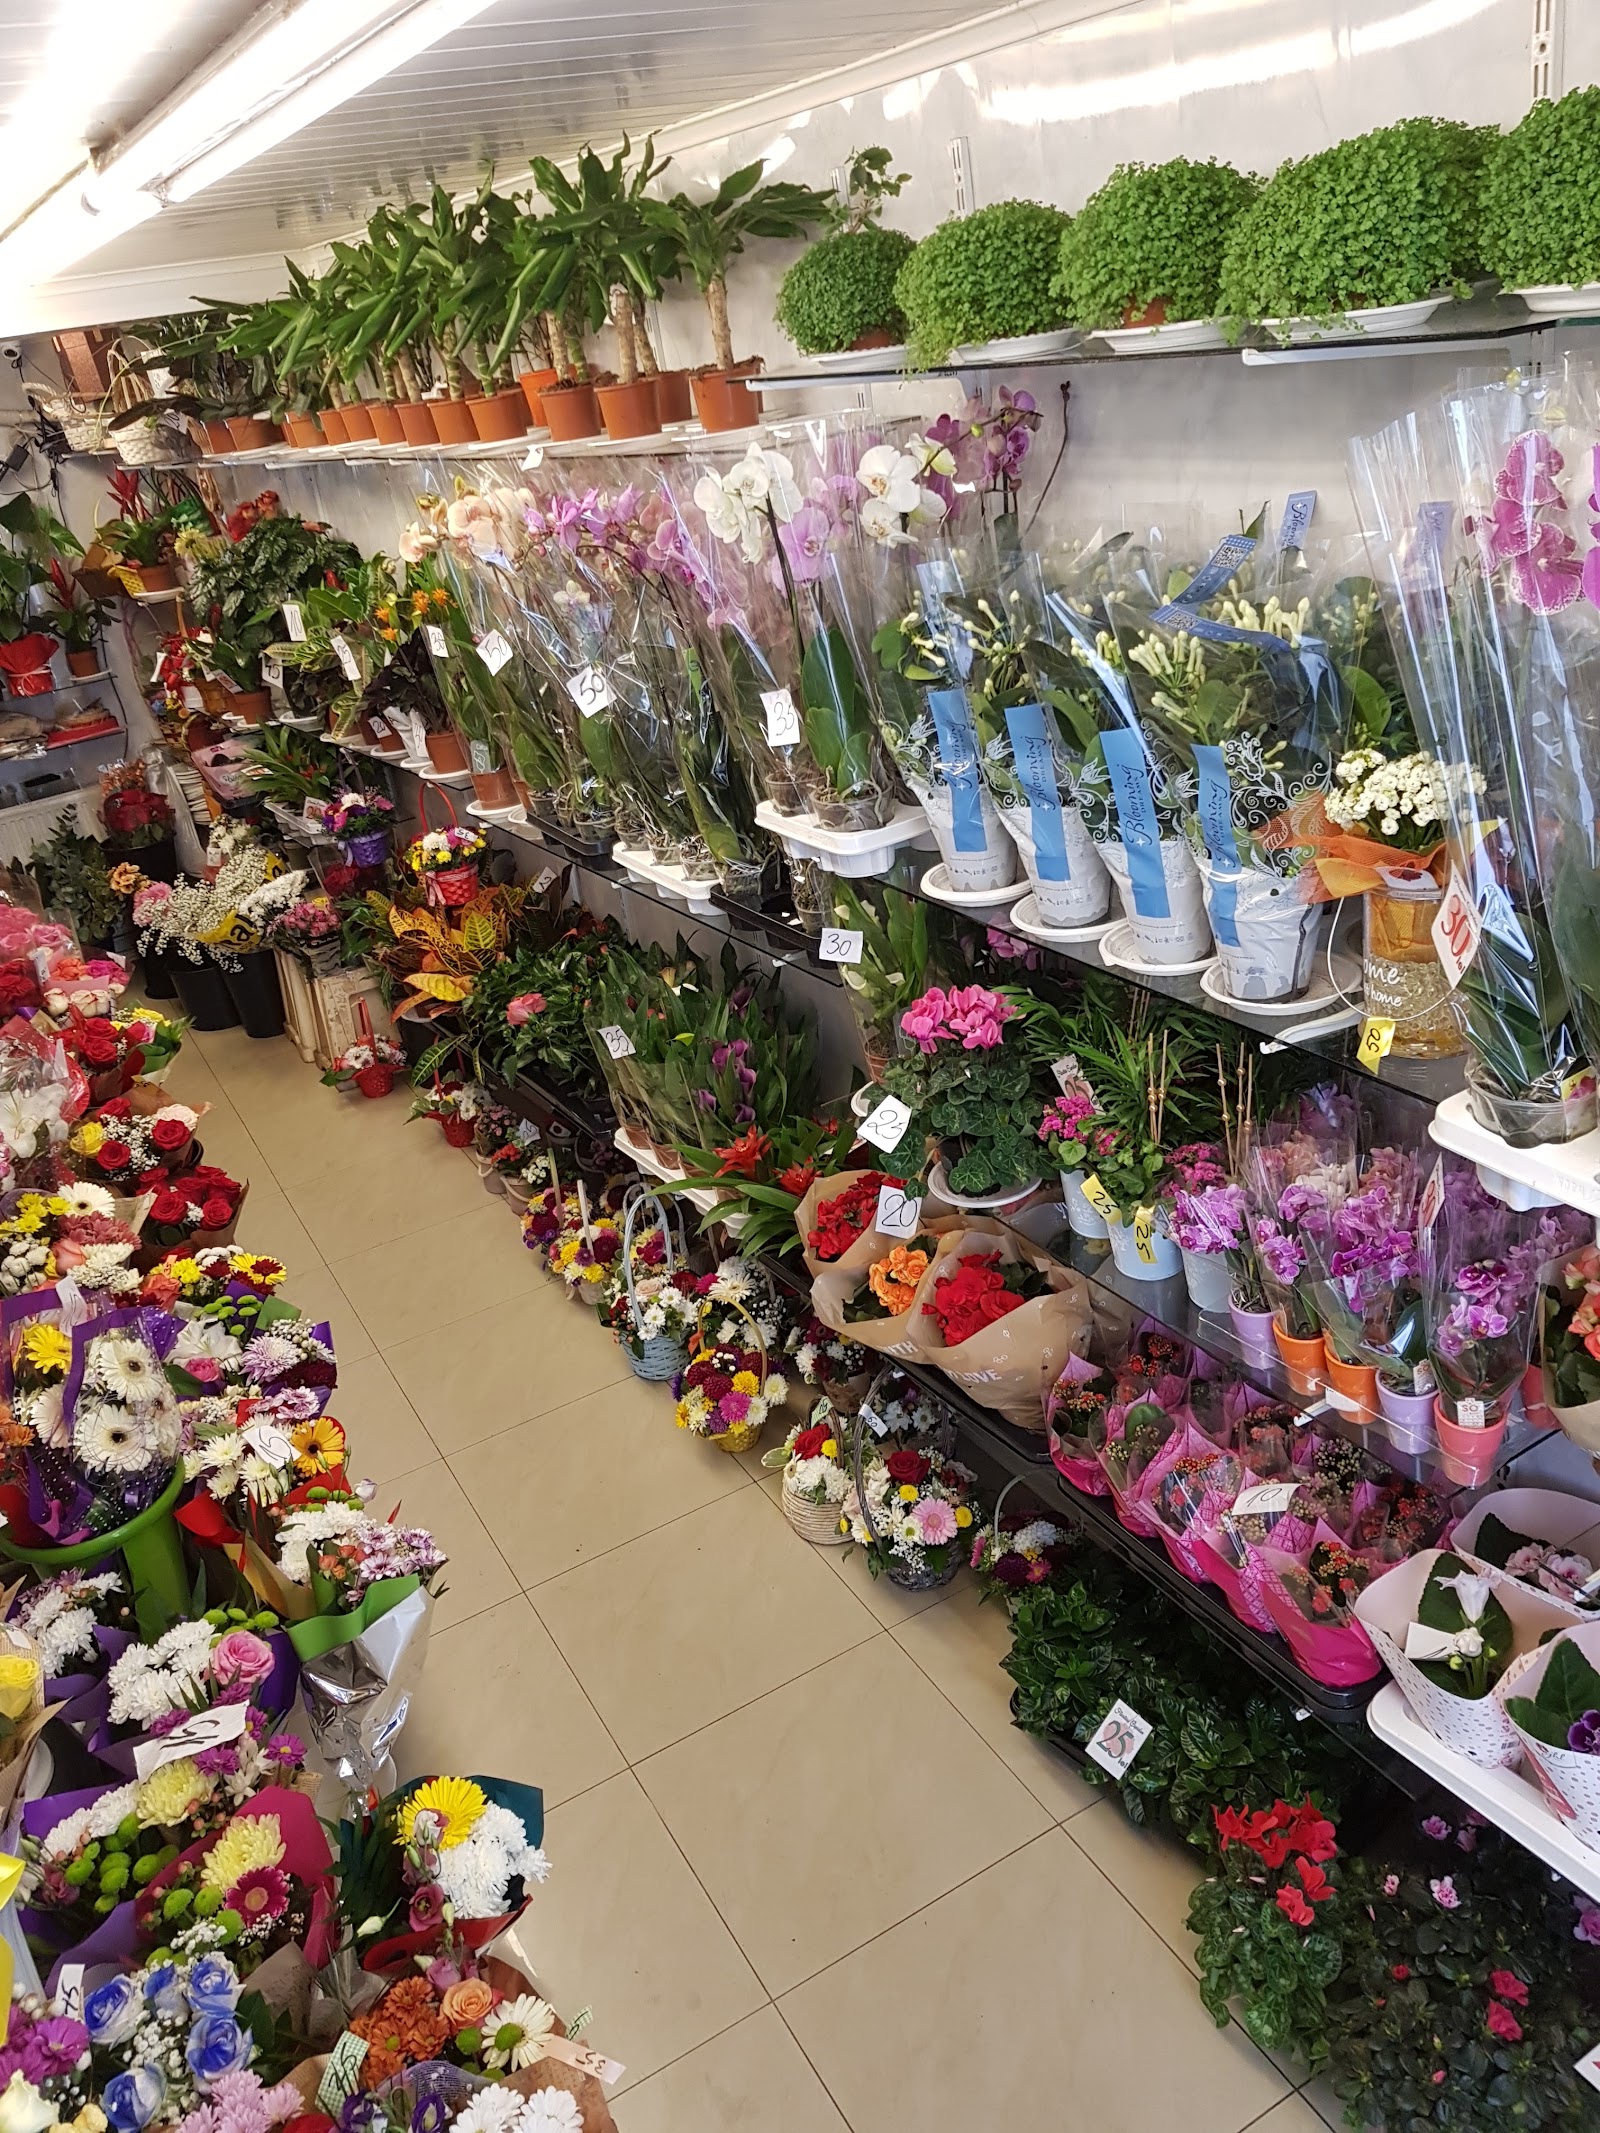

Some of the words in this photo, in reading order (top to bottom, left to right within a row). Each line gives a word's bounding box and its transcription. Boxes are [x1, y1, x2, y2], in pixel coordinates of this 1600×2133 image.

[485, 635, 509, 668] 50
[579, 673, 606, 706] 50
[1019, 735, 1056, 811] Blooming
[1116, 763, 1153, 846] Blooming
[1133, 776, 1147, 814] DREAMS
[1440, 894, 1471, 957] 30
[826, 933, 852, 957] 30
[605, 1029, 631, 1055] 35
[1365, 1027, 1381, 1053] 50
[867, 1109, 908, 1140] 25
[881, 1193, 919, 1228] 20
[1092, 1191, 1118, 1214] 25
[1136, 1223, 1151, 1260] 25
[1461, 1404, 1479, 1413] SO
[1246, 1486, 1284, 1508] 10
[1095, 1720, 1135, 1759] 25
[574, 2050, 608, 2075] 35
